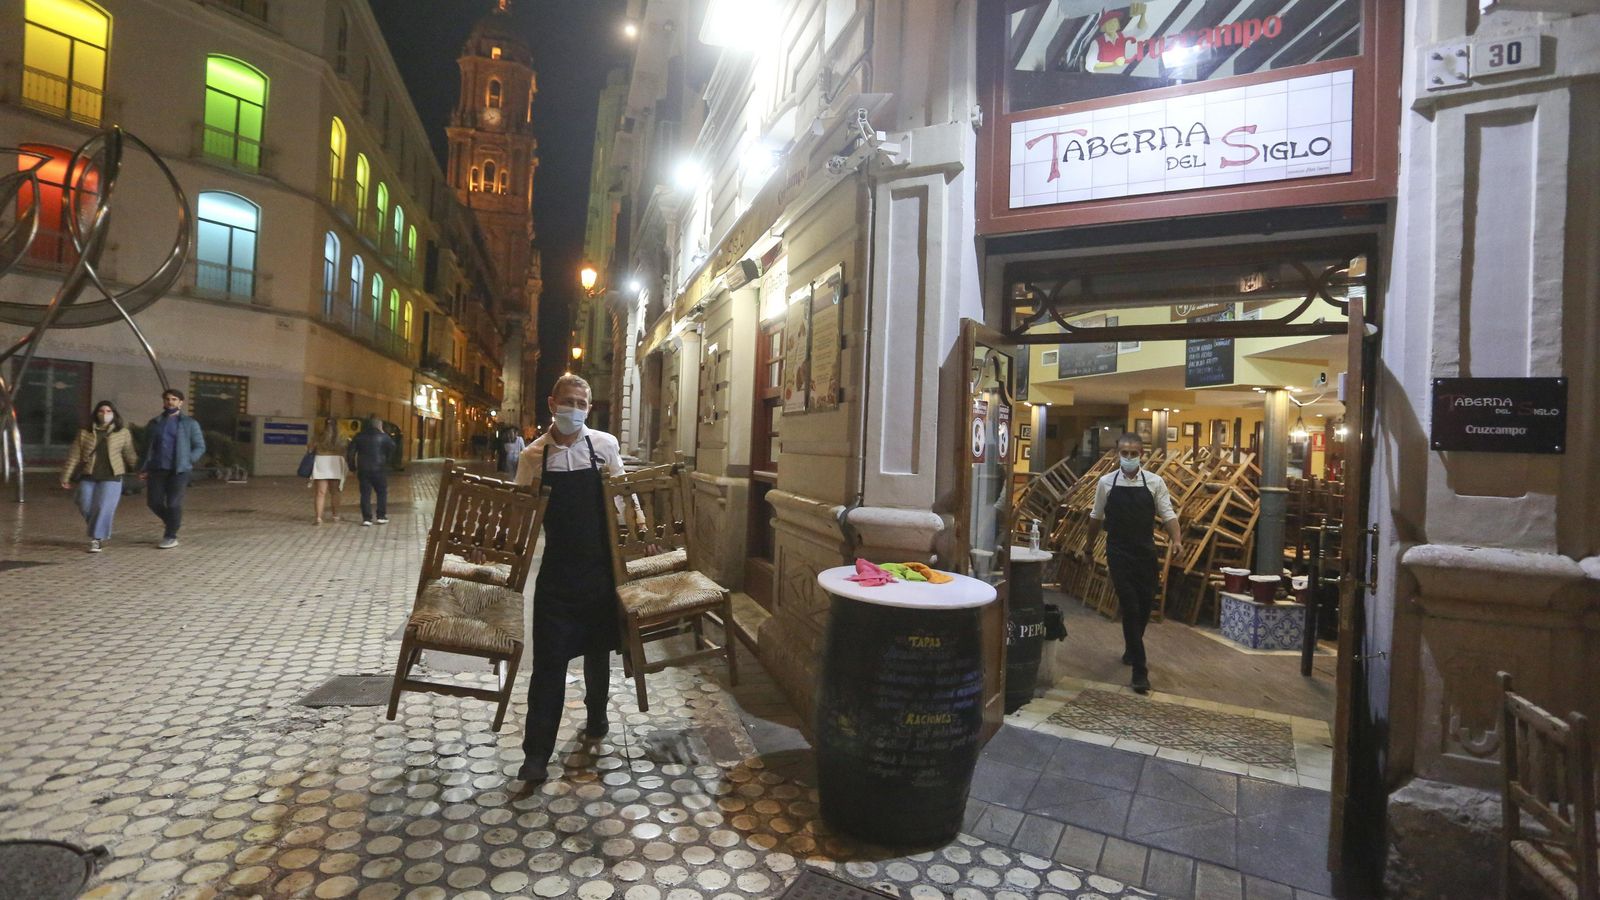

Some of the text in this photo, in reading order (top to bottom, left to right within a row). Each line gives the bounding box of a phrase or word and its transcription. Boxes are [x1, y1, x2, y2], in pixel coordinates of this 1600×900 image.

[1489, 41, 1522, 68] 30
[1025, 121, 1332, 182] TABERNA DEL SIGLO
[1465, 424, 1527, 436] Cruzcampo
[907, 635, 942, 649] TAPAS
[905, 712, 952, 726] RACIONES
